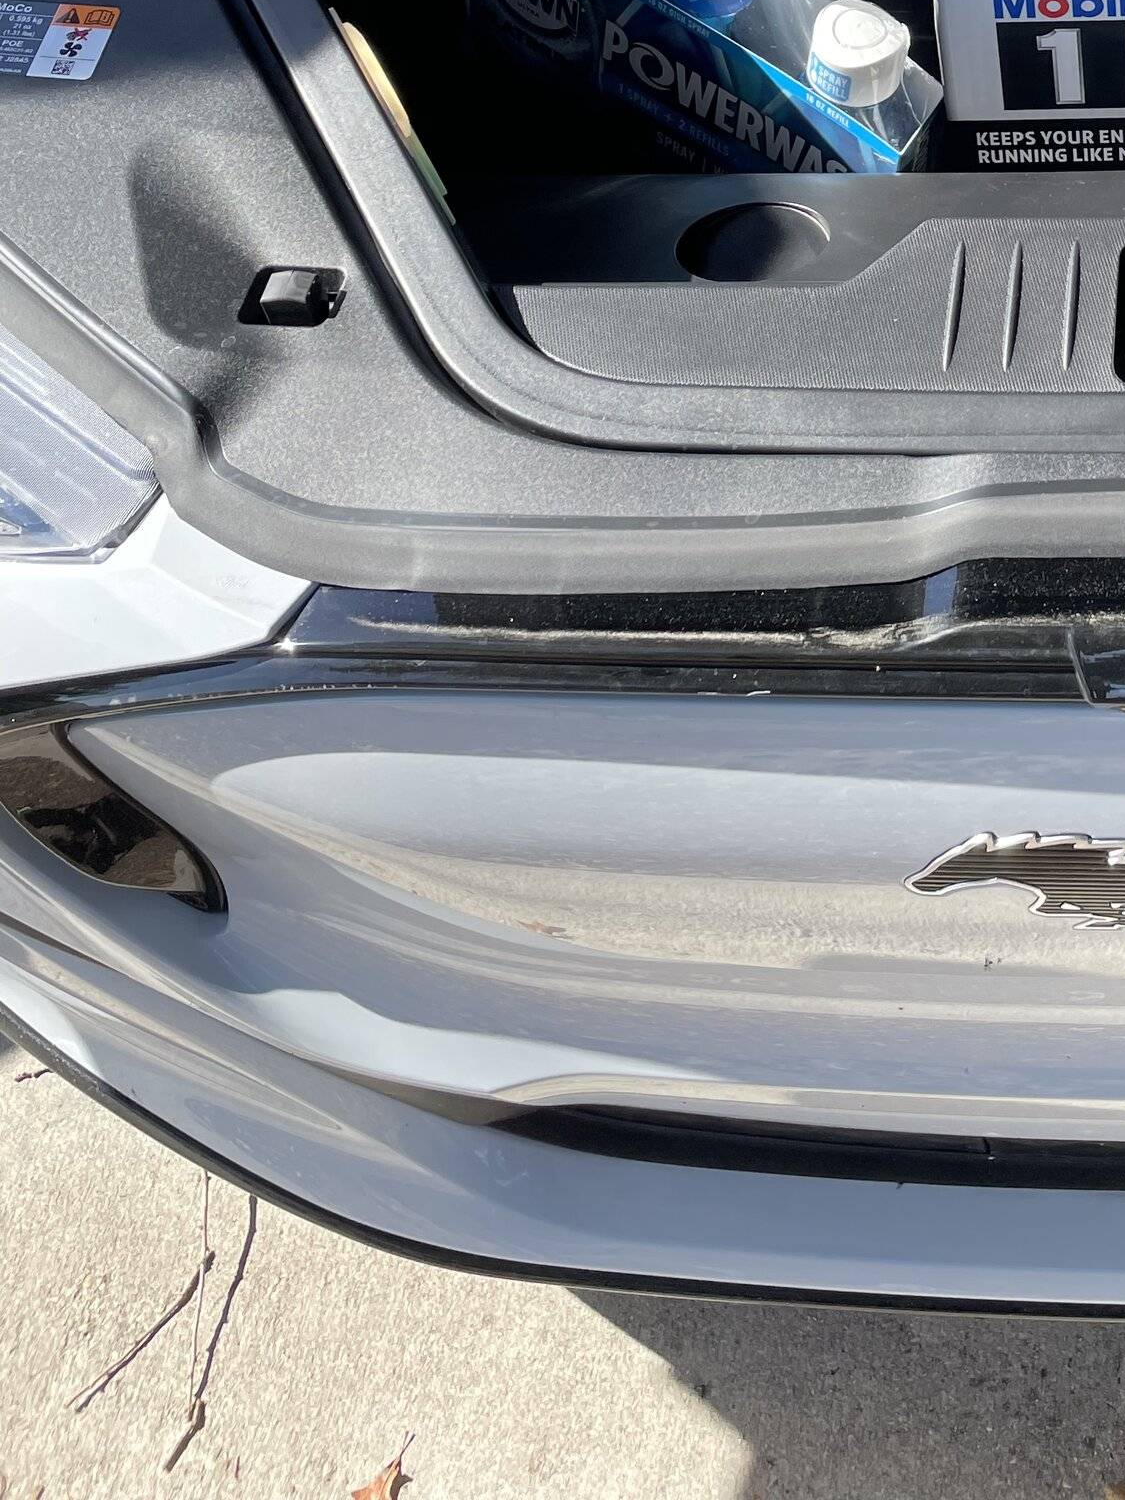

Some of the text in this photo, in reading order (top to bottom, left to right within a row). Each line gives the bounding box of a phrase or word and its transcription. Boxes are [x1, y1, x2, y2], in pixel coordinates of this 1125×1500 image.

[819, 66, 848, 87] SPRAY
[1036, 28, 1085, 105] 1
[817, 76, 847, 100] REFILL
[826, 107, 850, 128] REFILL
[656, 131, 696, 164] SPRAY
[976, 132, 1036, 146] KEEPS
[1040, 130, 1094, 145] YOUR
[978, 148, 1068, 163] RUNNING
[1072, 148, 1113, 162] LIKE
